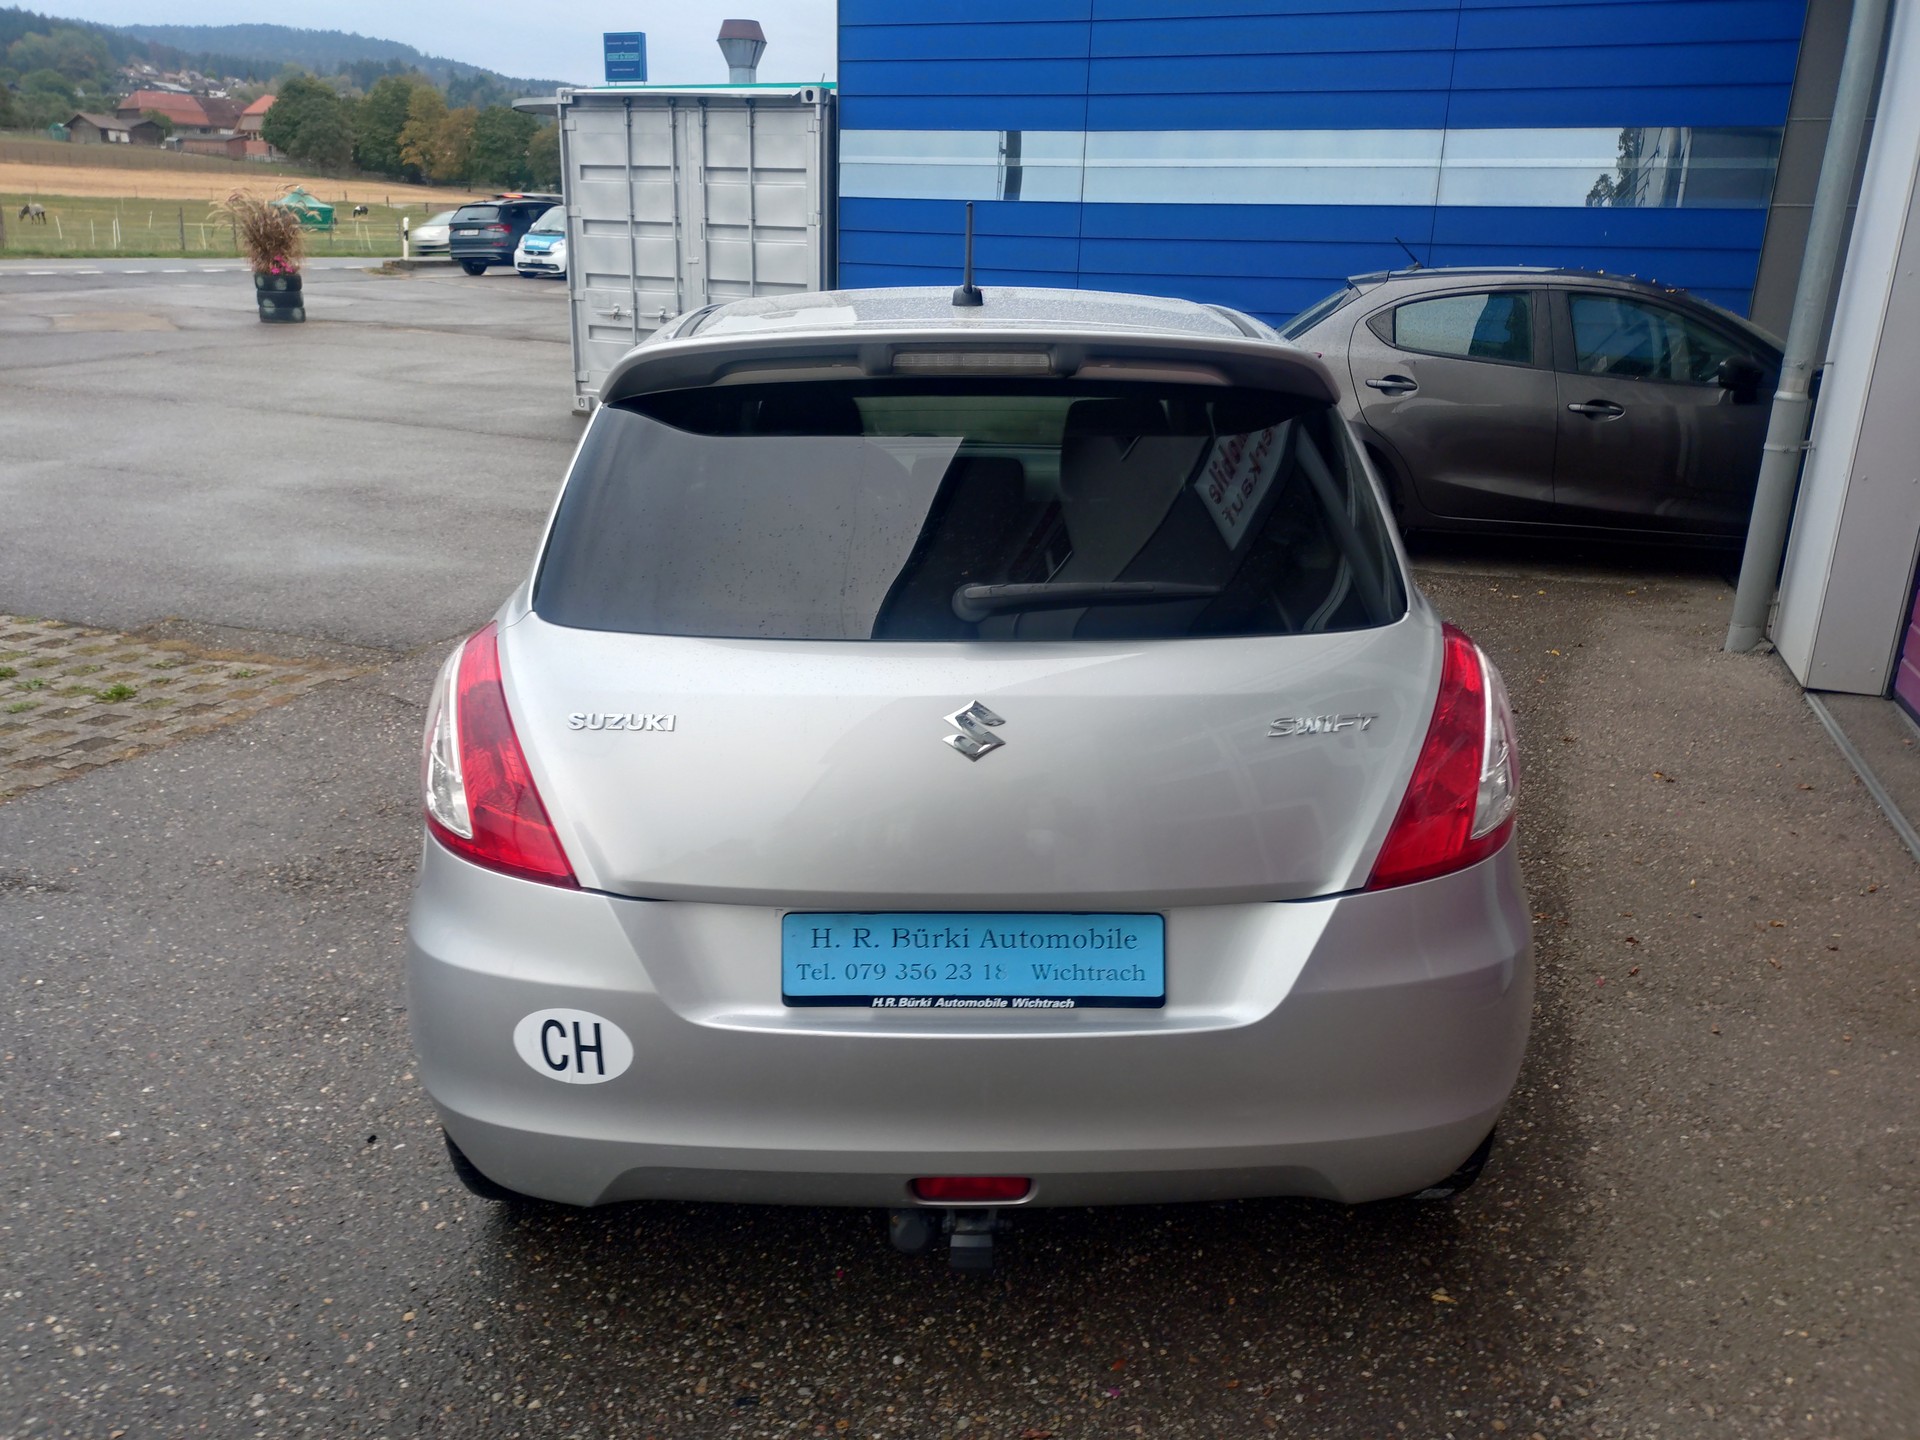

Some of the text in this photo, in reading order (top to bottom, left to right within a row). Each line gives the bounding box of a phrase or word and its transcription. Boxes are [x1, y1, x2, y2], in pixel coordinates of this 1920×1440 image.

[567, 712, 676, 732] SUZUKI
[1266, 713, 1379, 737] SWIFT
[811, 927, 1138, 950] H. R. Bürki Automobile
[796, 963, 836, 981] Tel.
[845, 963, 886, 981] 079
[895, 963, 937, 981] 356
[945, 963, 972, 981] 23
[1031, 963, 1146, 982] Wichtrach
[935, 997, 1008, 1008] Automobile
[1011, 998, 1075, 1008] Wichtrach
[541, 1019, 605, 1075] CH
